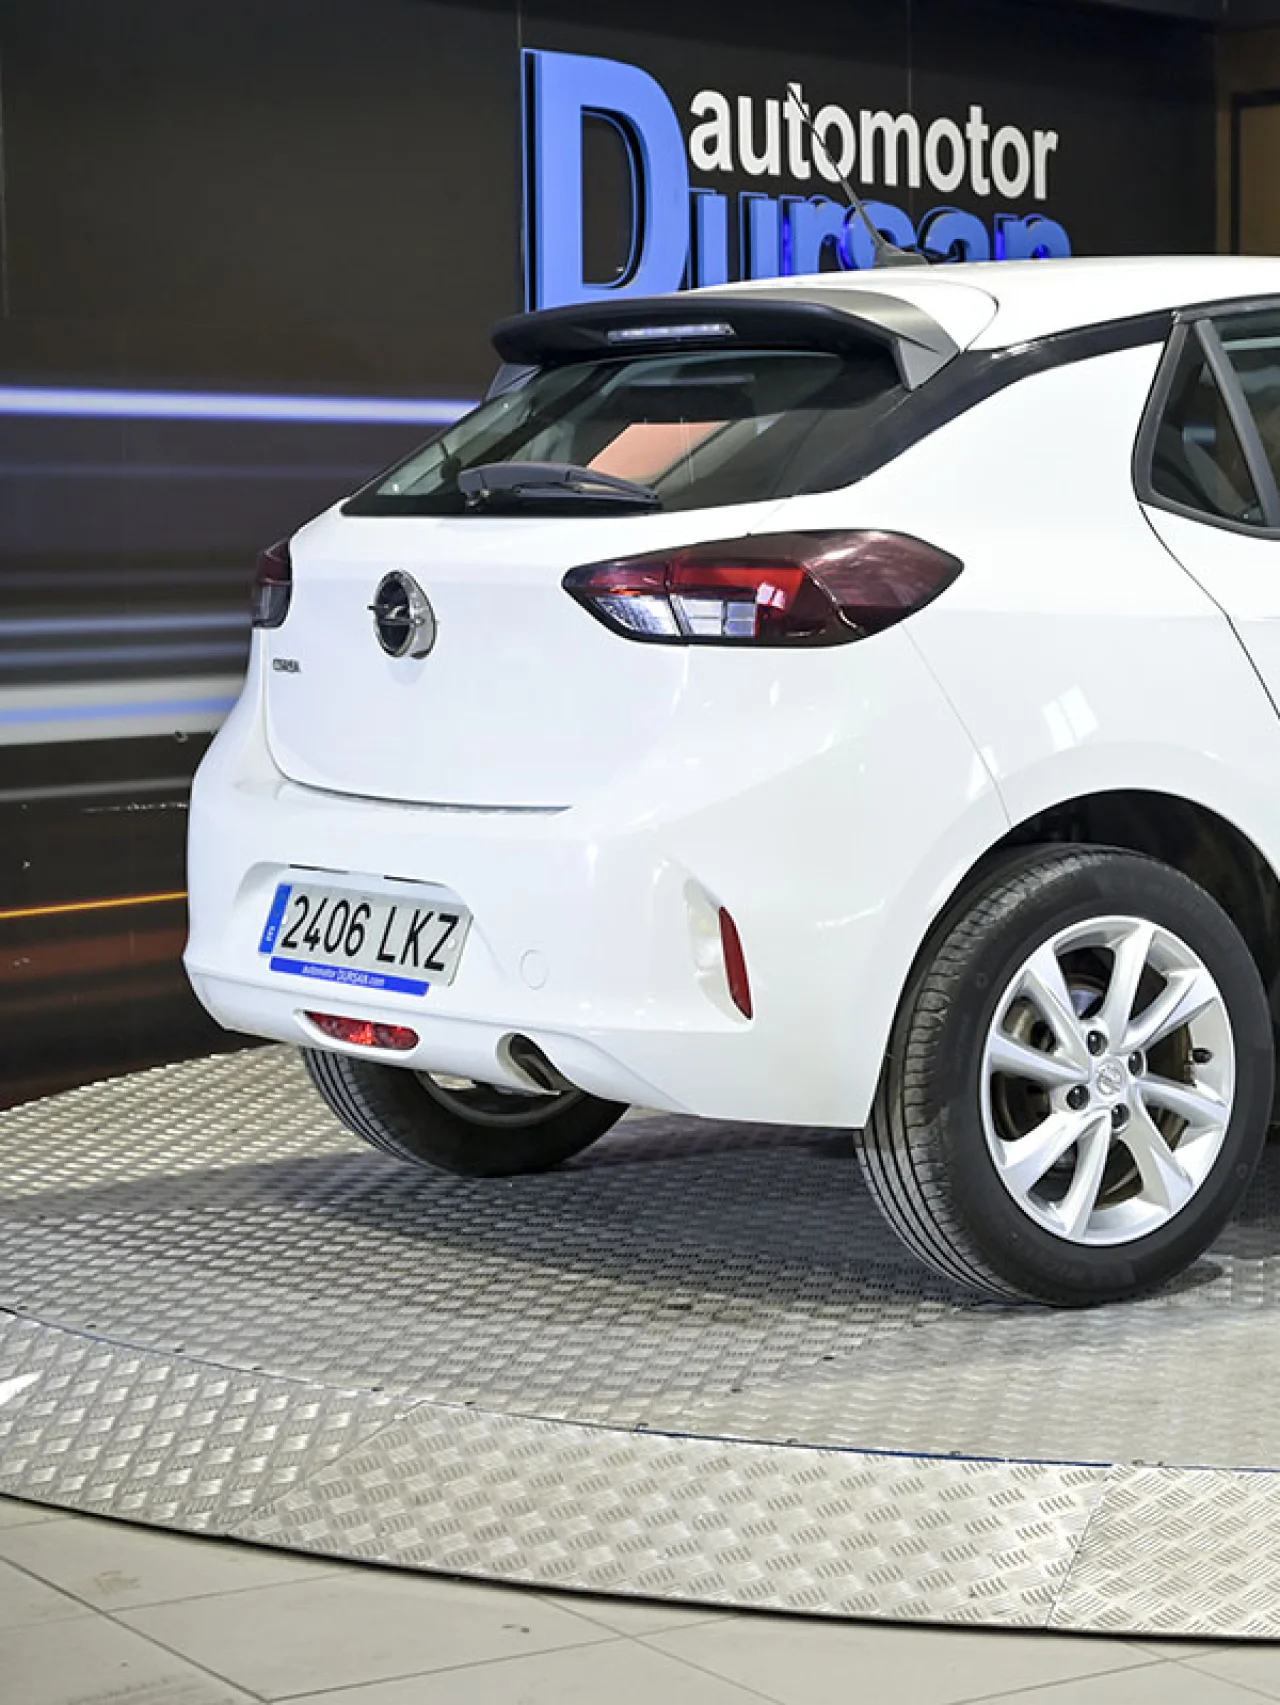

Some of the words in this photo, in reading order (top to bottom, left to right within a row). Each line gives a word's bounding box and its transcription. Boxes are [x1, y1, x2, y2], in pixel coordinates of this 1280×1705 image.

[690, 82, 1059, 200] automotor
[281, 894, 372, 957] 2406
[376, 905, 460, 972] LKZ
